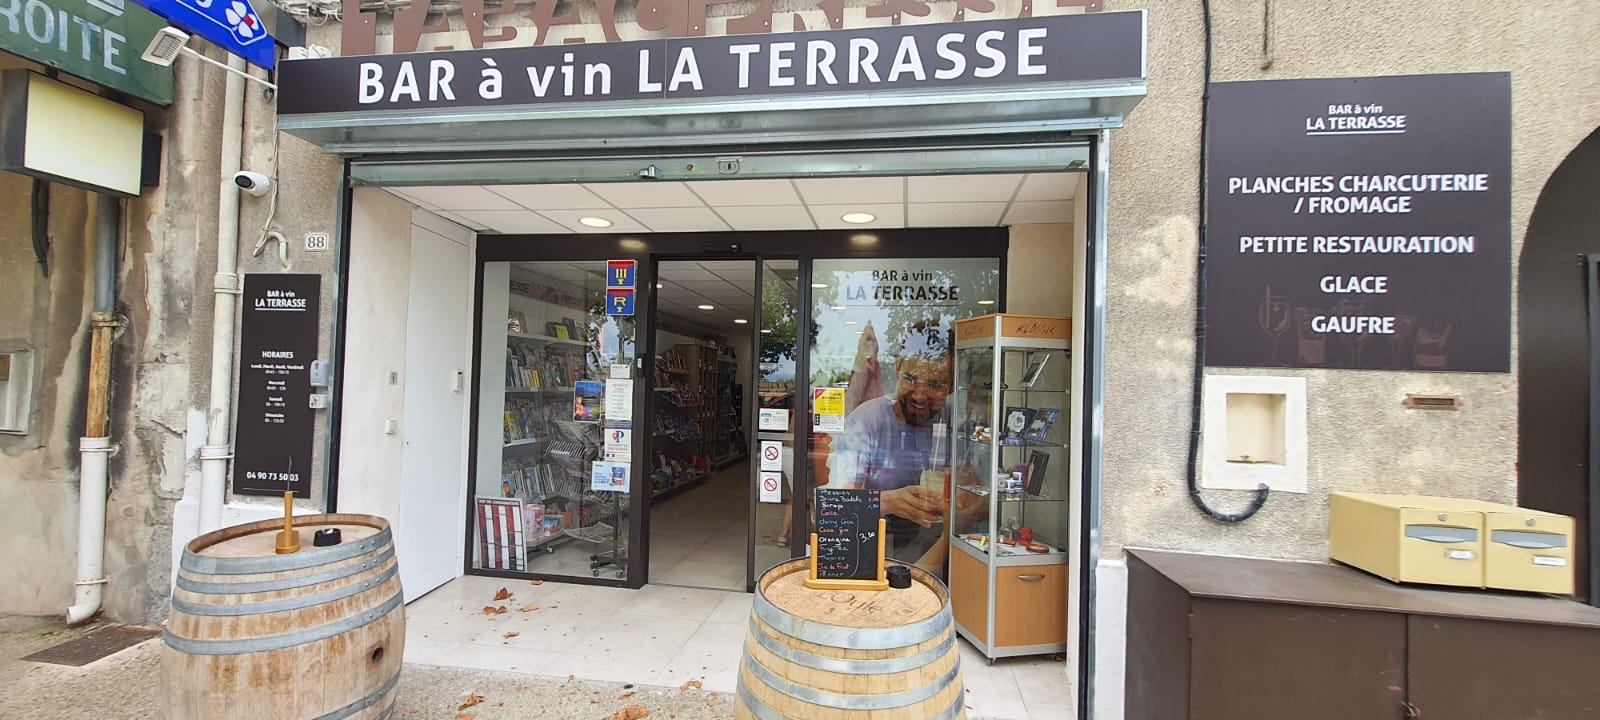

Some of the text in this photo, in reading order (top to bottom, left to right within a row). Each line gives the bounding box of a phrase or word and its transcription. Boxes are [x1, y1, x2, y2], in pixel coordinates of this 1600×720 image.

[358, 27, 1048, 104] BAR à vin LA TERRASSE
[1328, 103, 1382, 115] BAR à vin
[1306, 115, 1407, 130] LA TERRASSE
[1228, 173, 1489, 194] PLANCHES CHARCUTERIE
[1293, 196, 1412, 214] / FROMAGE
[308, 236, 324, 248] 88
[1240, 236, 1475, 254] PETITE RESTAURATION
[872, 270, 932, 282] BAR à vin
[1320, 276, 1388, 294] GLACE
[266, 290, 280, 298] BAR
[846, 286, 958, 300] LA TERRASSE
[254, 298, 307, 308] LA TERRASSE
[1311, 316, 1396, 334] GAUFRE
[262, 350, 294, 359] HORAIRES
[257, 472, 267, 480] 90
